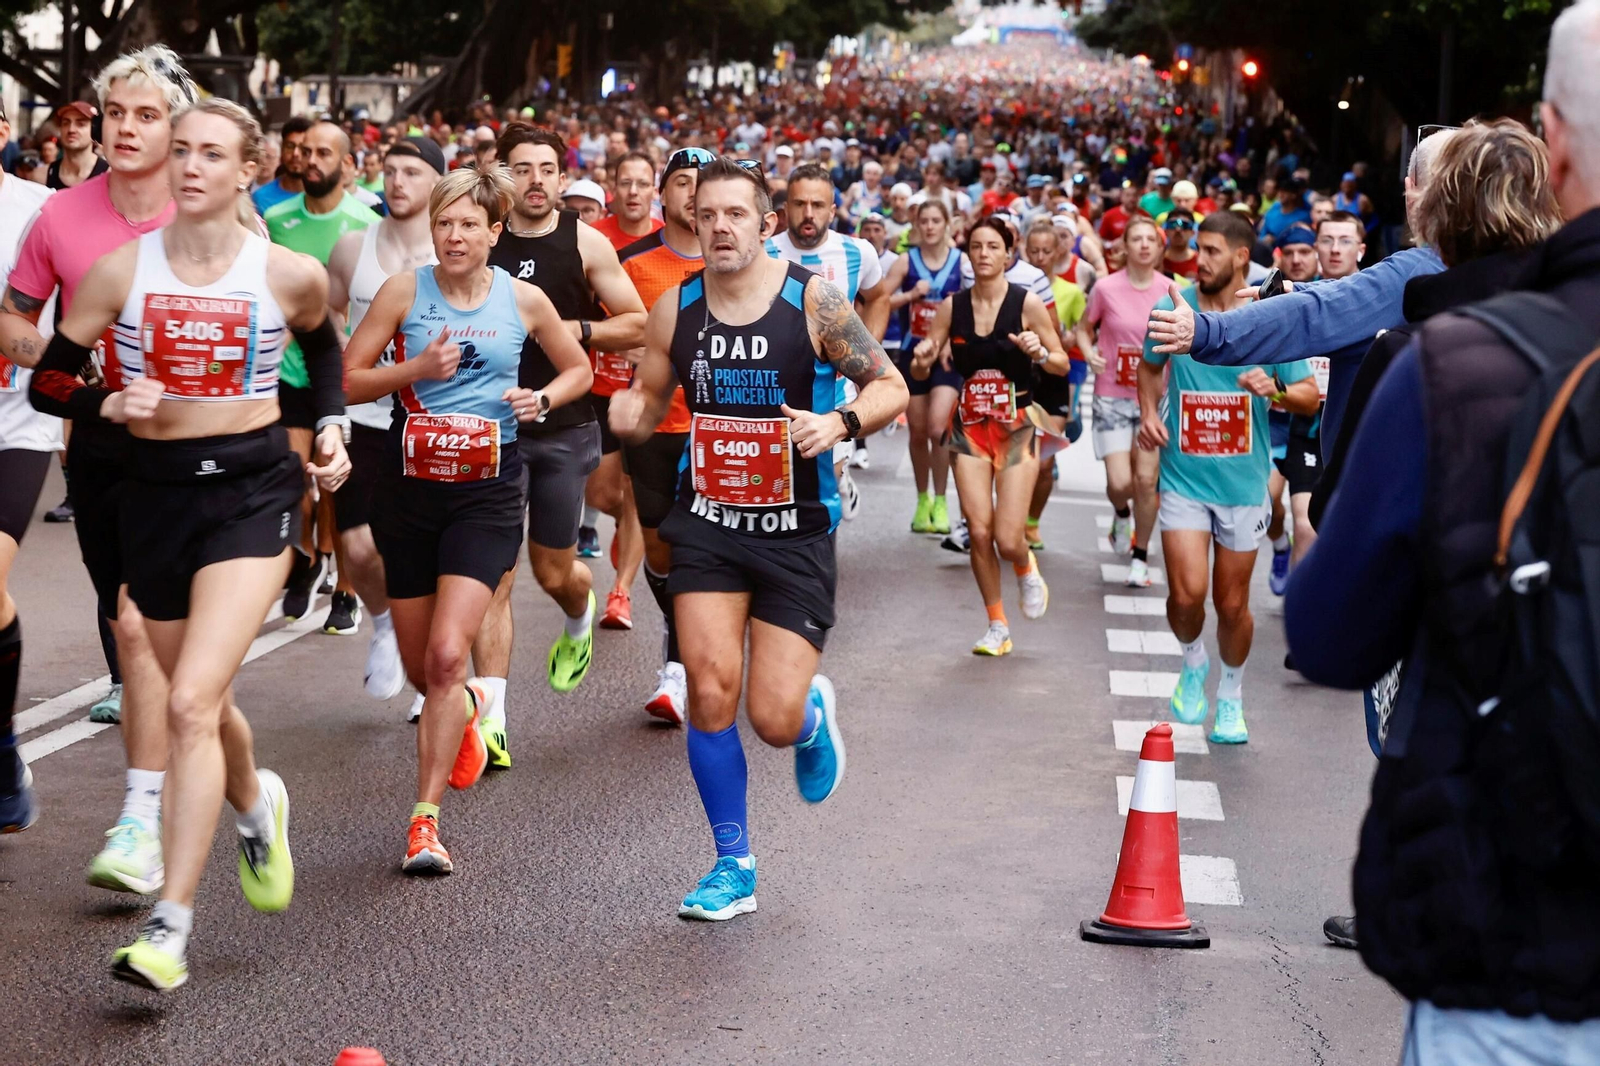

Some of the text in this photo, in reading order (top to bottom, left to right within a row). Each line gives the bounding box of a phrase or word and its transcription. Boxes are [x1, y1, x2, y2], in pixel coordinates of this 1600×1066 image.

[169, 297, 244, 314] GENERALI
[164, 319, 224, 342] 5406
[710, 335, 769, 360] DAD
[714, 368, 779, 387] PROSTATE
[715, 387, 786, 406] CANCER UK
[969, 383, 997, 394] 9642
[430, 417, 486, 430] GENERALI
[1195, 408, 1231, 423] 6094
[715, 420, 775, 434] GENERALI
[425, 432, 471, 450] 7422
[713, 439, 760, 458] 6400
[690, 492, 799, 533] NEWTON
